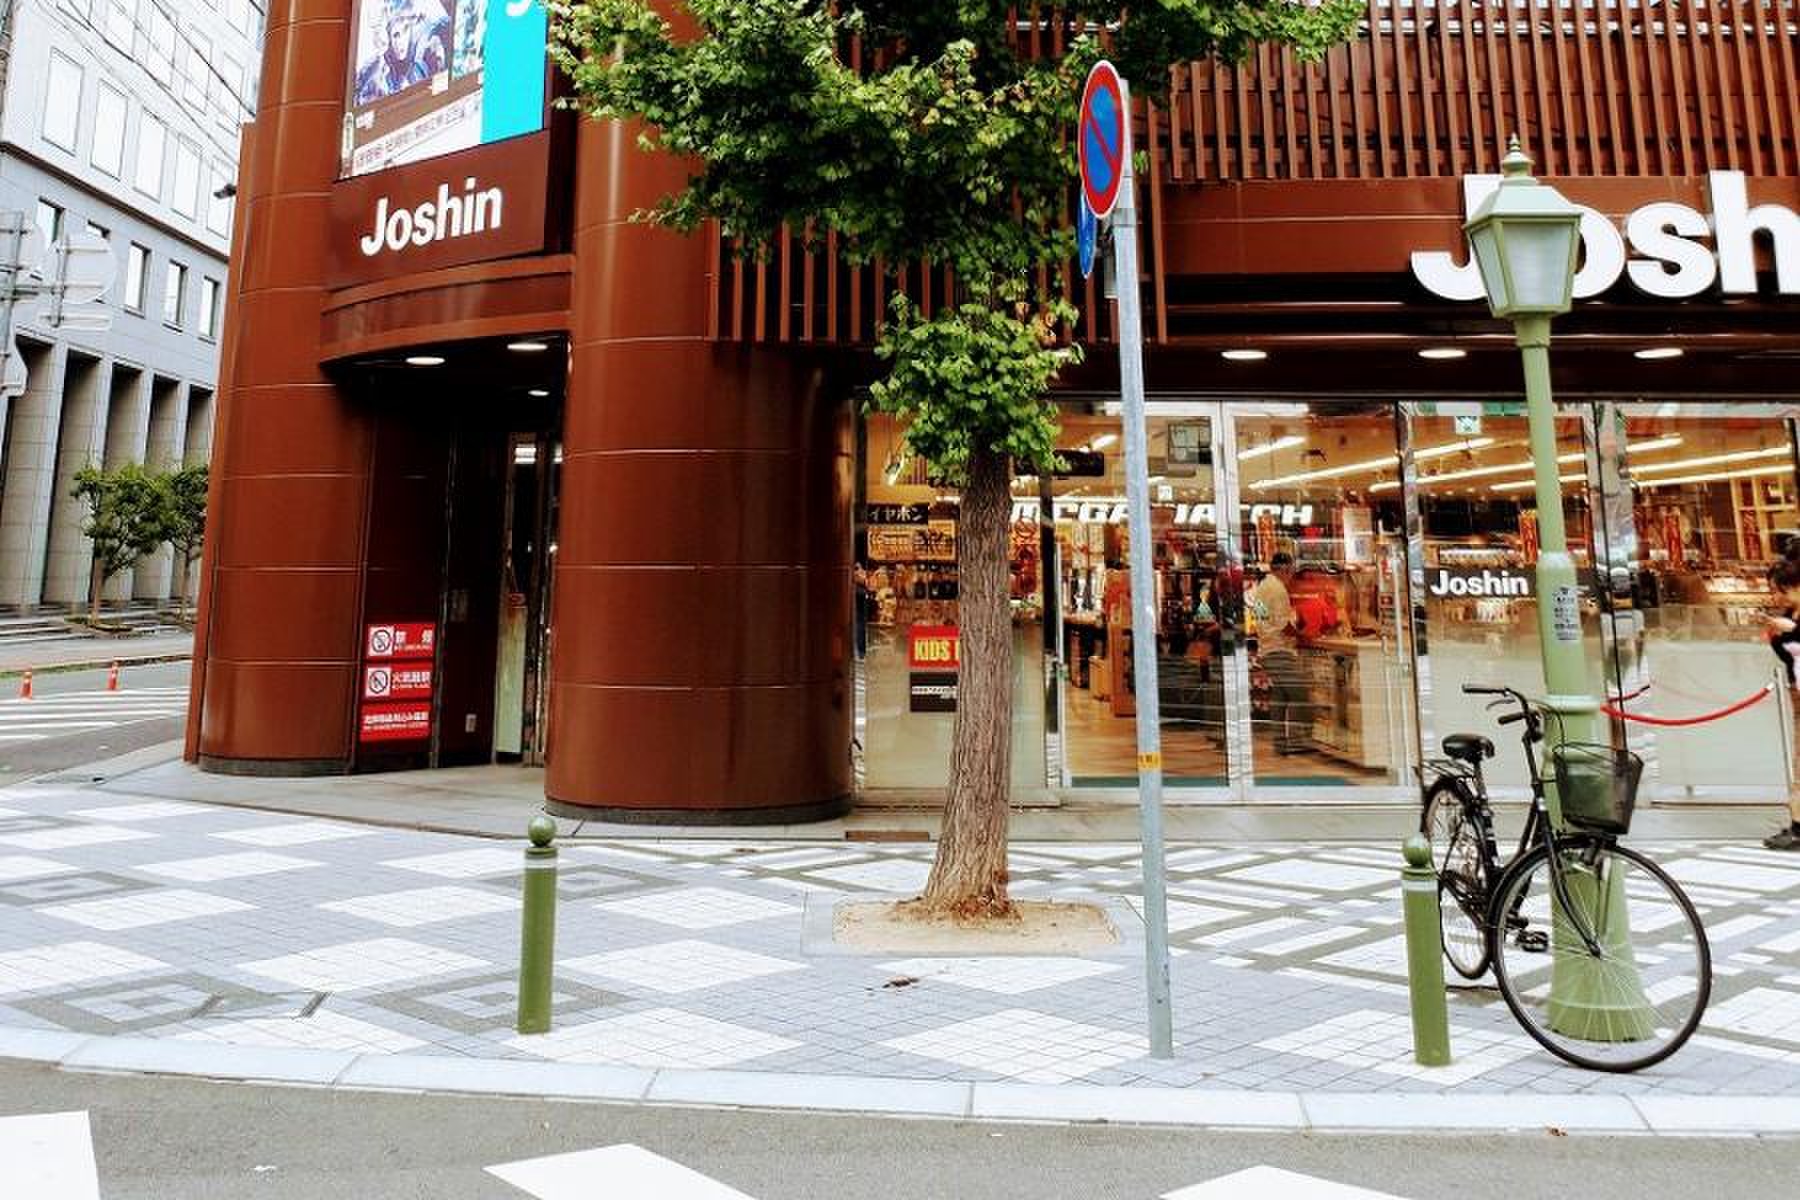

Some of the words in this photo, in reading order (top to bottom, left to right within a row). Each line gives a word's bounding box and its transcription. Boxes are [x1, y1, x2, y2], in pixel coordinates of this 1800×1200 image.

[360, 177, 503, 256] Joshin
[869, 505, 923, 521] イヤホン
[1430, 570, 1529, 596] Joshin
[914, 637, 951, 661] KIDS
